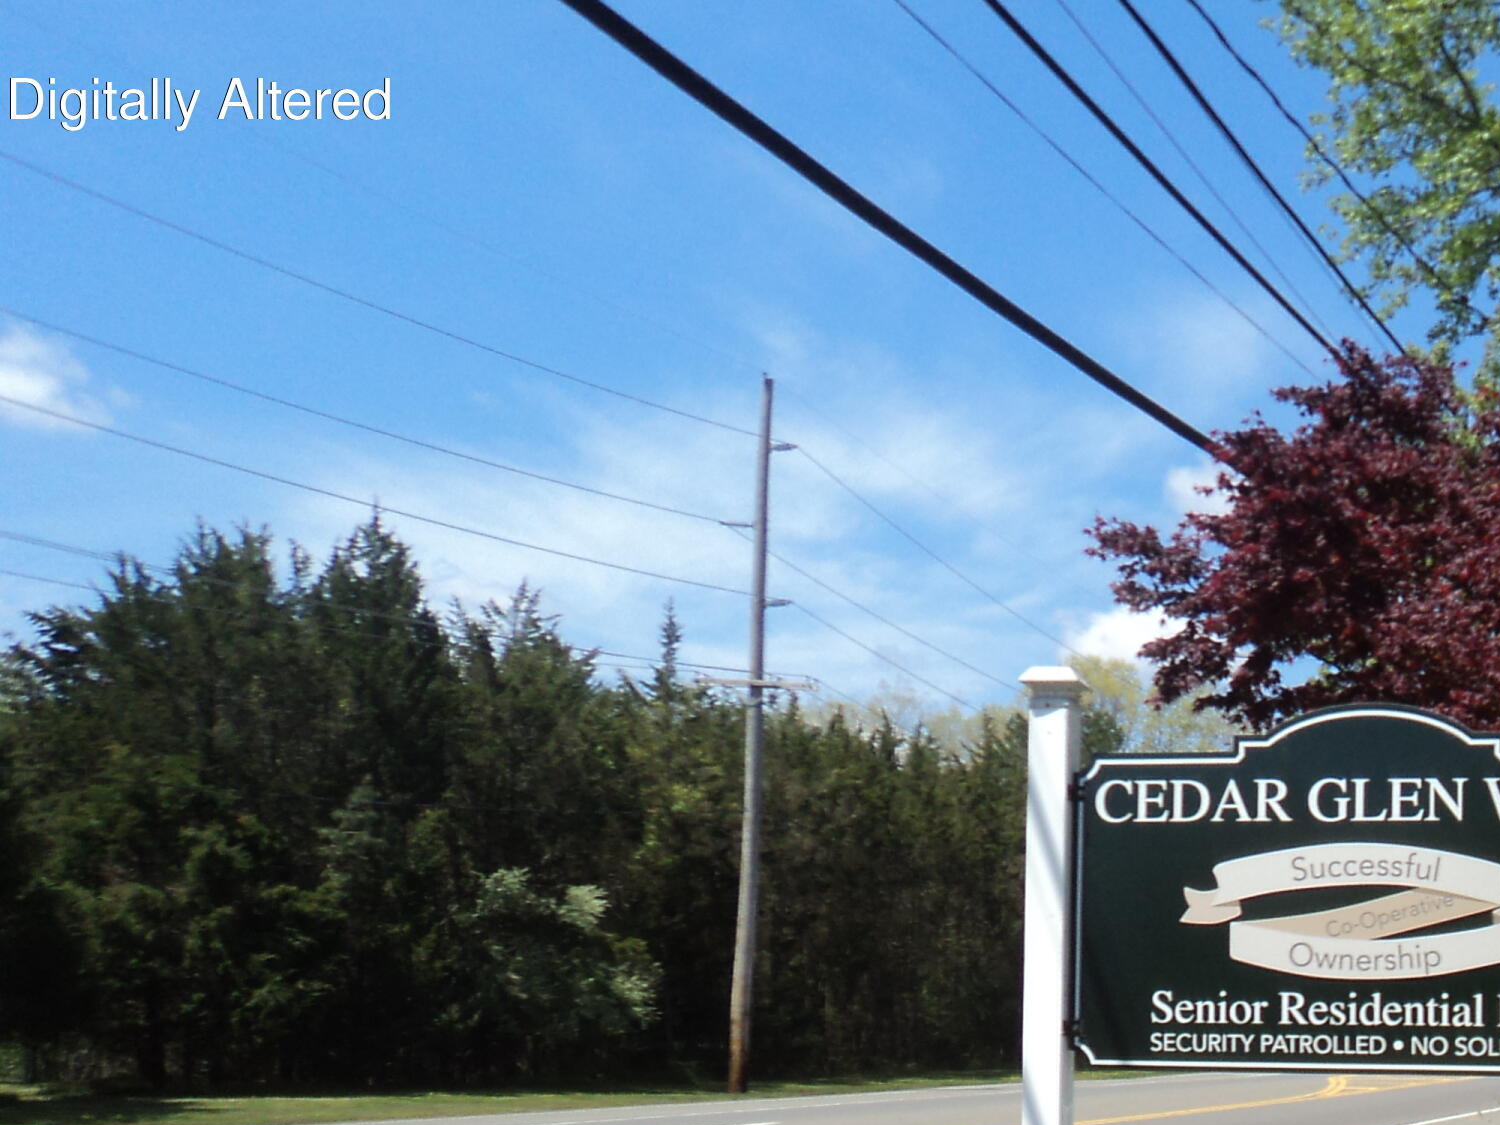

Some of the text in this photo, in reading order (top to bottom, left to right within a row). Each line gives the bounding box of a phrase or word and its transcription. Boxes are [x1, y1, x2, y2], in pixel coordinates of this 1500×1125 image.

[1094, 778, 1293, 823] CEDAR
[1307, 777, 1464, 822] GLEN
[1291, 853, 1441, 882] Successful
[1325, 894, 1454, 938] Co-Operative
[1289, 942, 1441, 975] Ownership
[1151, 990, 1268, 1025] Senior
[1278, 991, 1485, 1028] Residential
[1150, 1033, 1255, 1053] SECURITY
[1260, 1034, 1387, 1055] PATROLLED
[1411, 1036, 1449, 1056] NO
